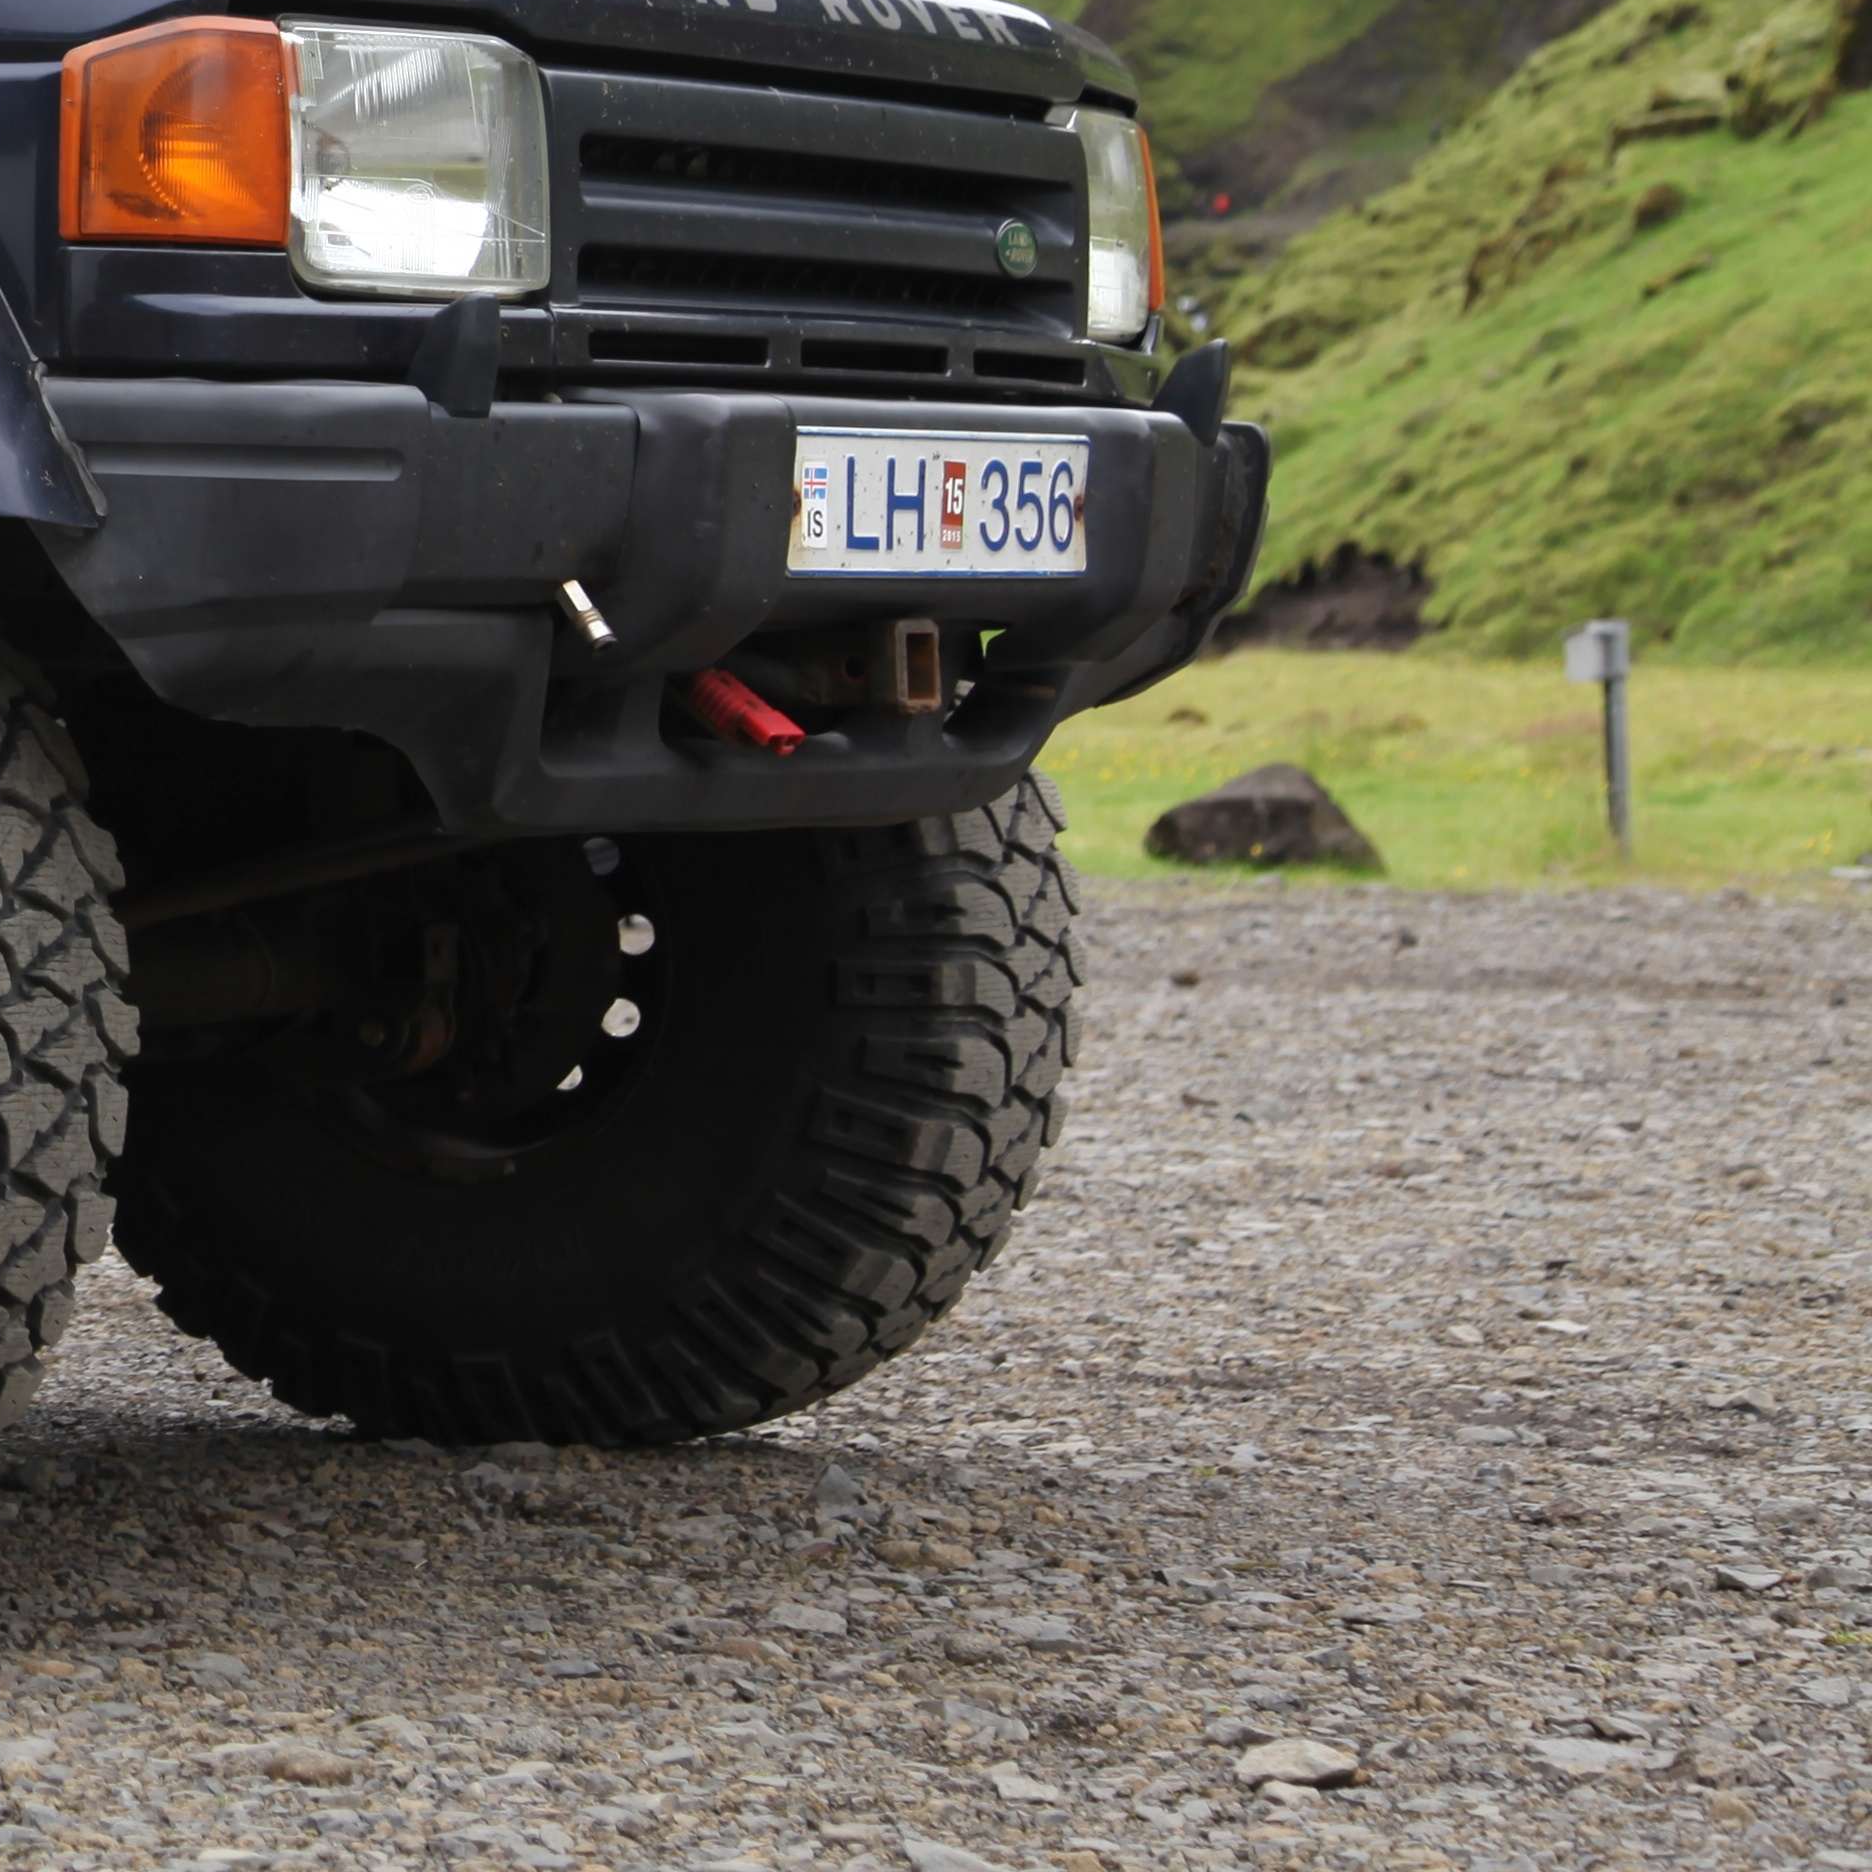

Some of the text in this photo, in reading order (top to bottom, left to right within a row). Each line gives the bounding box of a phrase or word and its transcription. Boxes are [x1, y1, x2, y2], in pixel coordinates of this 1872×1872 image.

[845, 455, 1075, 552] LH 356
[944, 477, 964, 515] 15
[807, 509, 823, 538] IS
